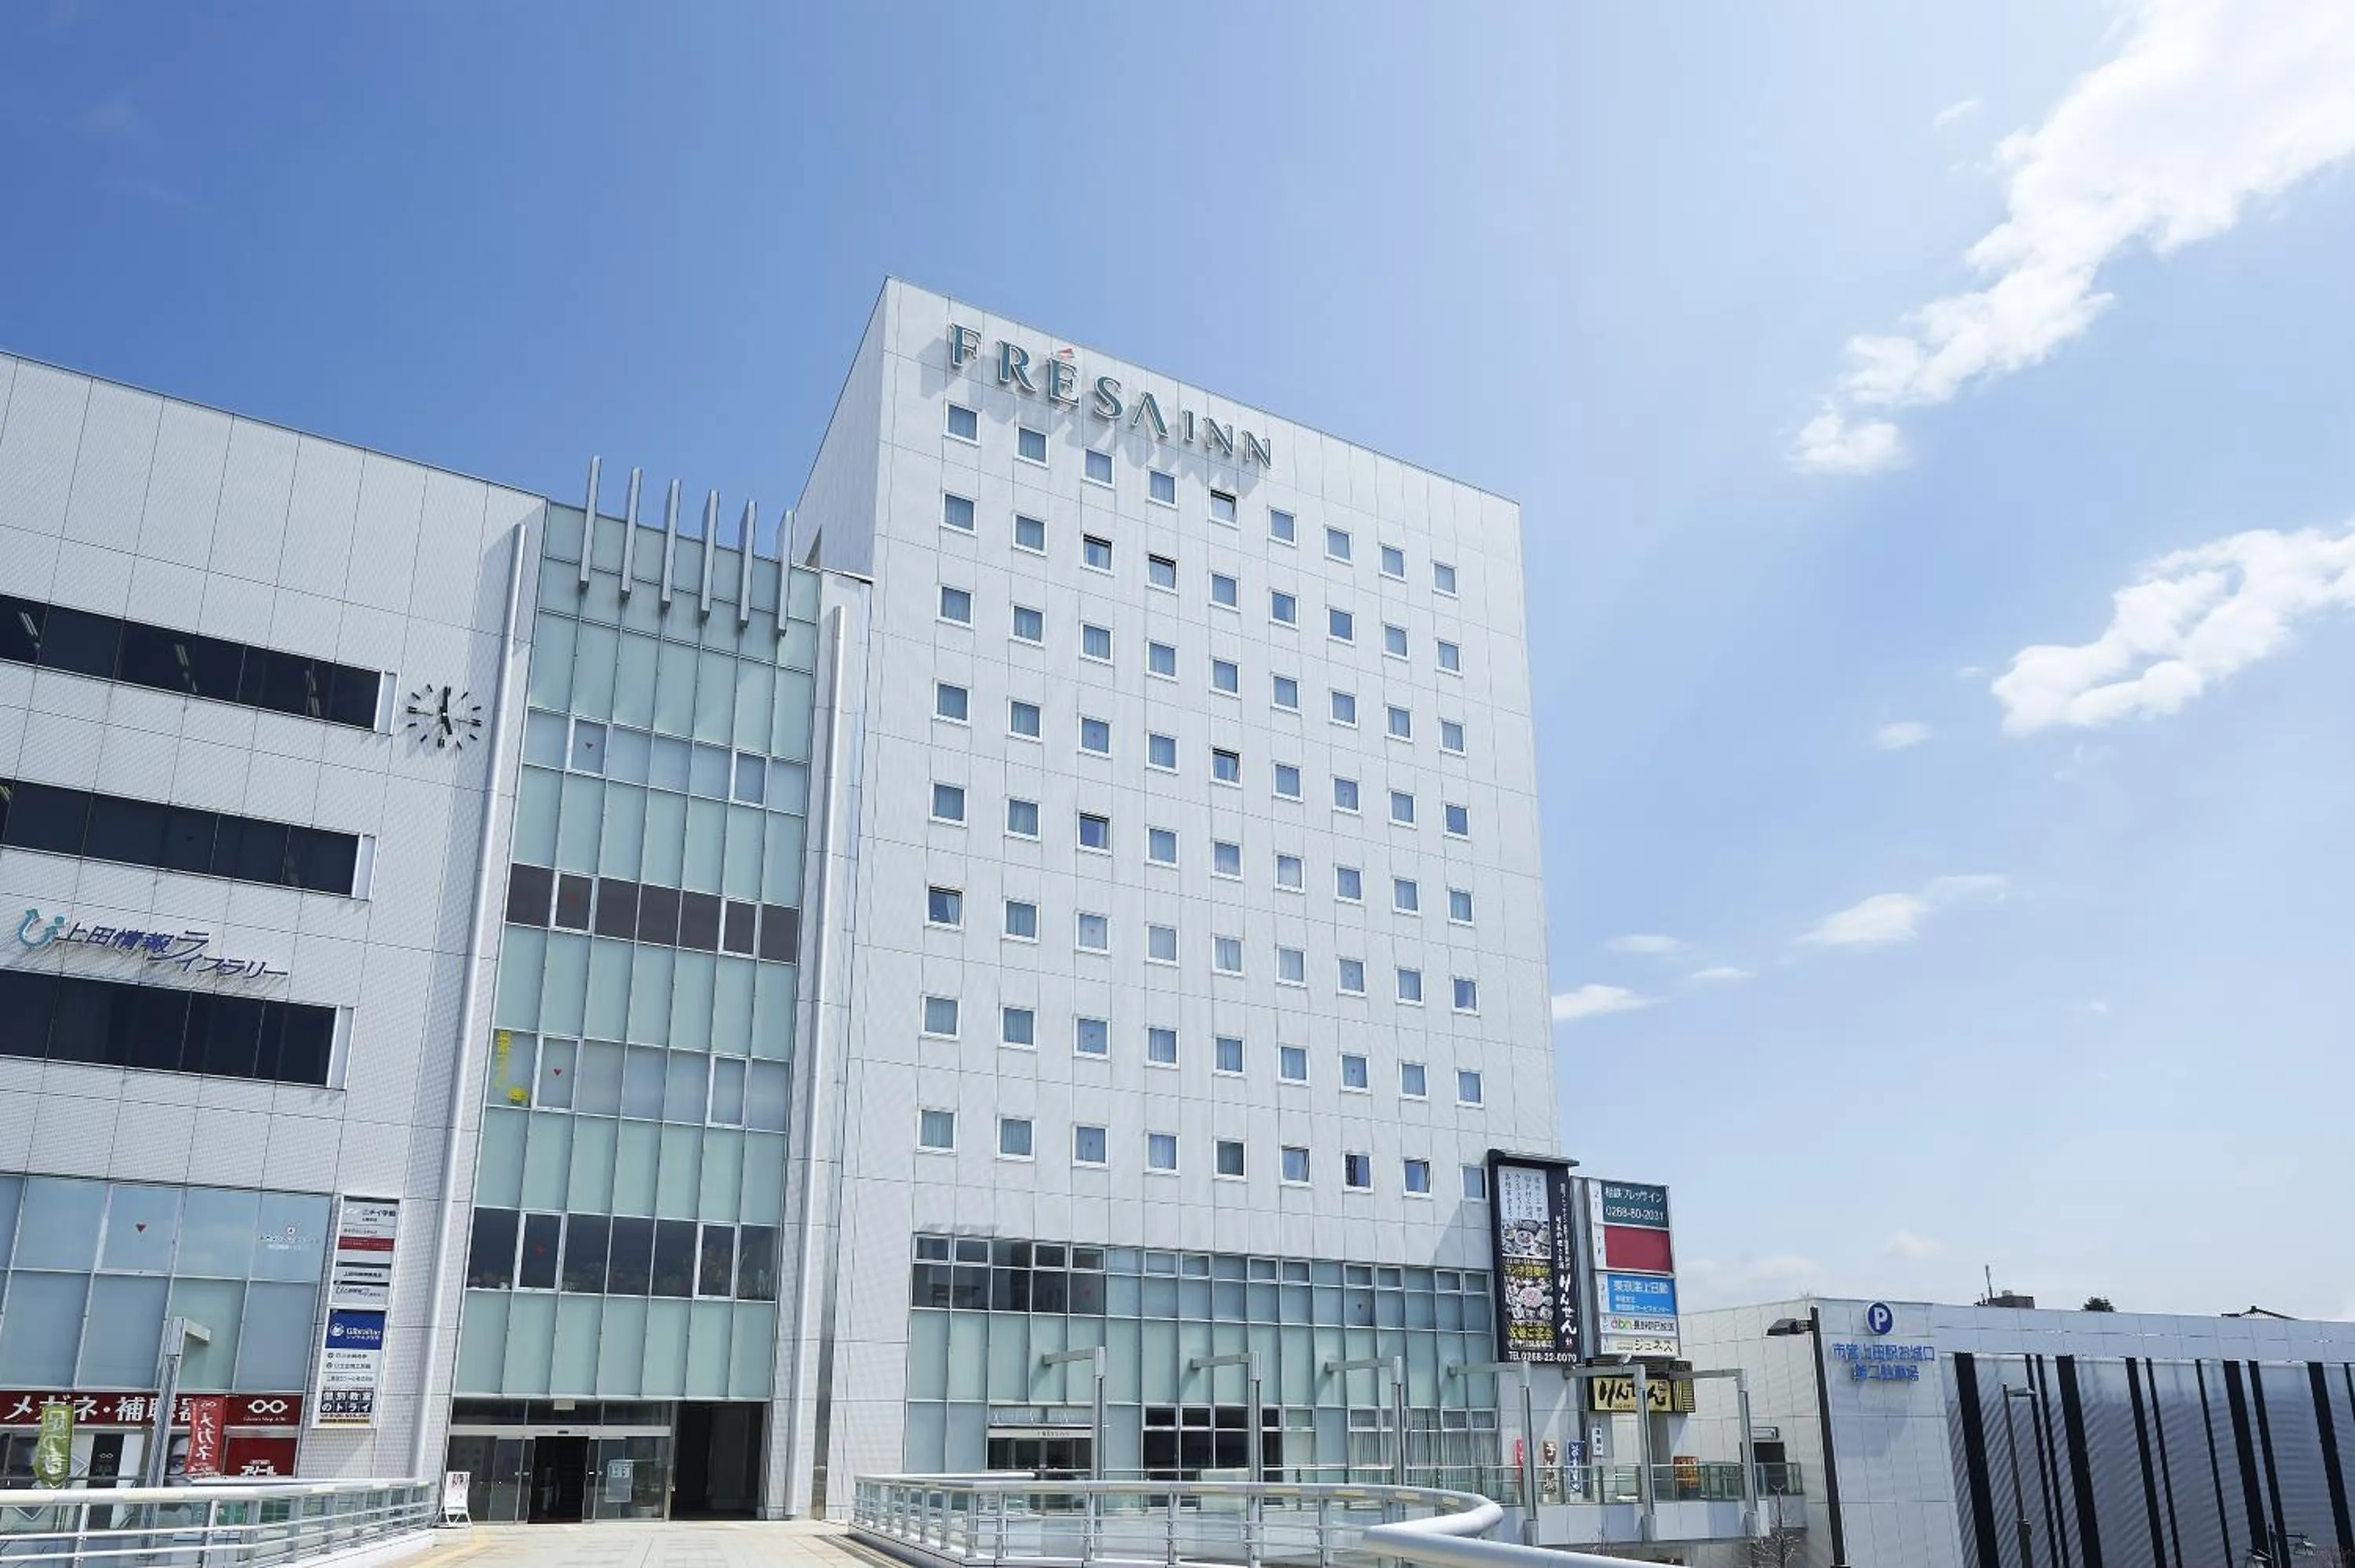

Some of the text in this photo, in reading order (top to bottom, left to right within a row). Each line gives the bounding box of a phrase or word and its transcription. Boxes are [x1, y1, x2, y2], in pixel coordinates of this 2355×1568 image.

[1181, 409, 1272, 469] INN
[53, 922, 289, 979] 上田情報ライブラリー
[1874, 1307, 1888, 1330] P
